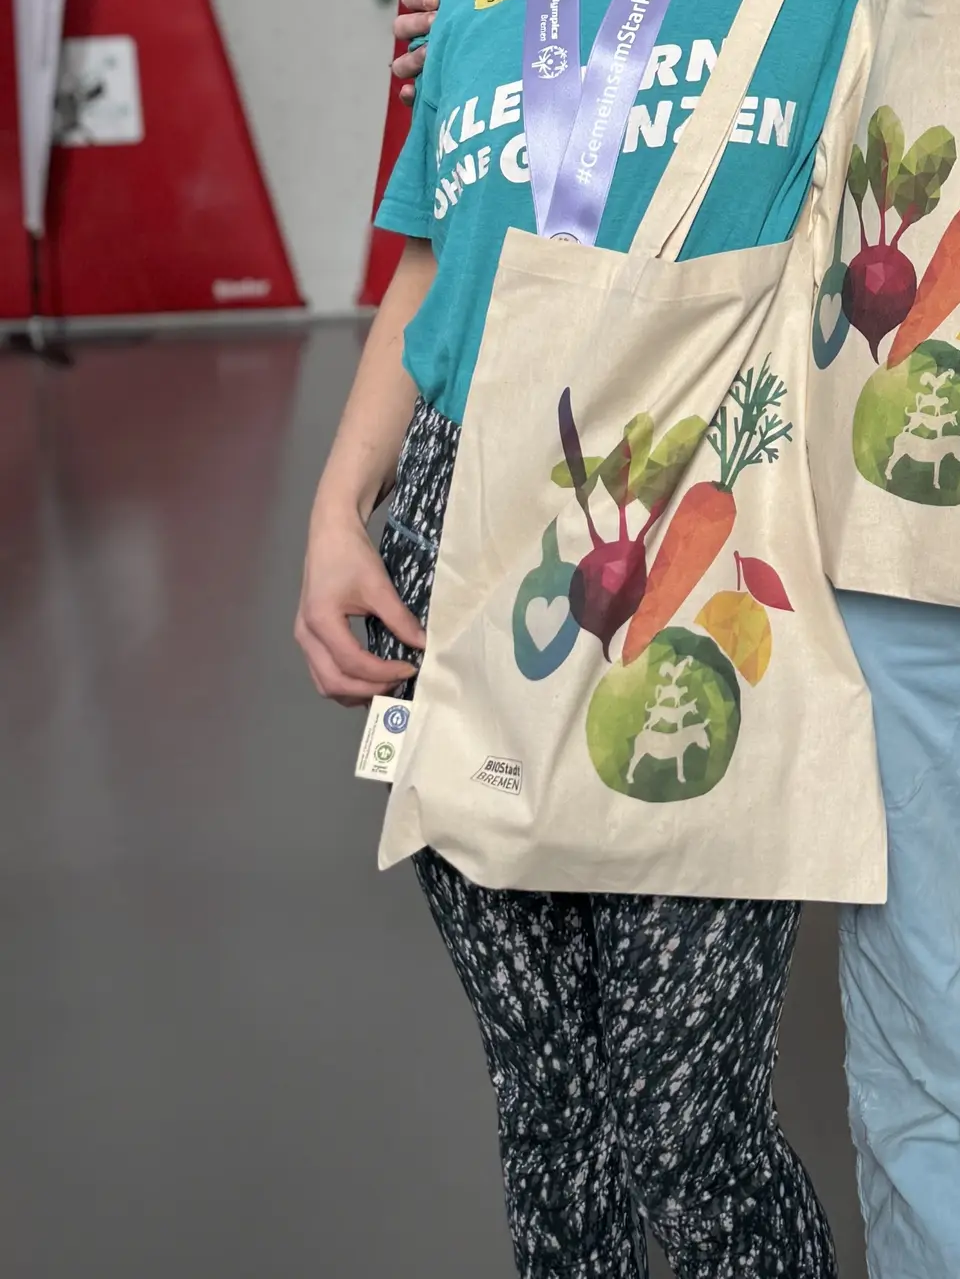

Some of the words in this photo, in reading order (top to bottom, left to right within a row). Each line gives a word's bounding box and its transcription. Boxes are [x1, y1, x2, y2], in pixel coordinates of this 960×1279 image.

[540, 14, 549, 42] Bremen
[433, 145, 492, 220] OHNE
[484, 760, 521, 777] BIOStadt
[476, 771, 520, 791] BREMEN
